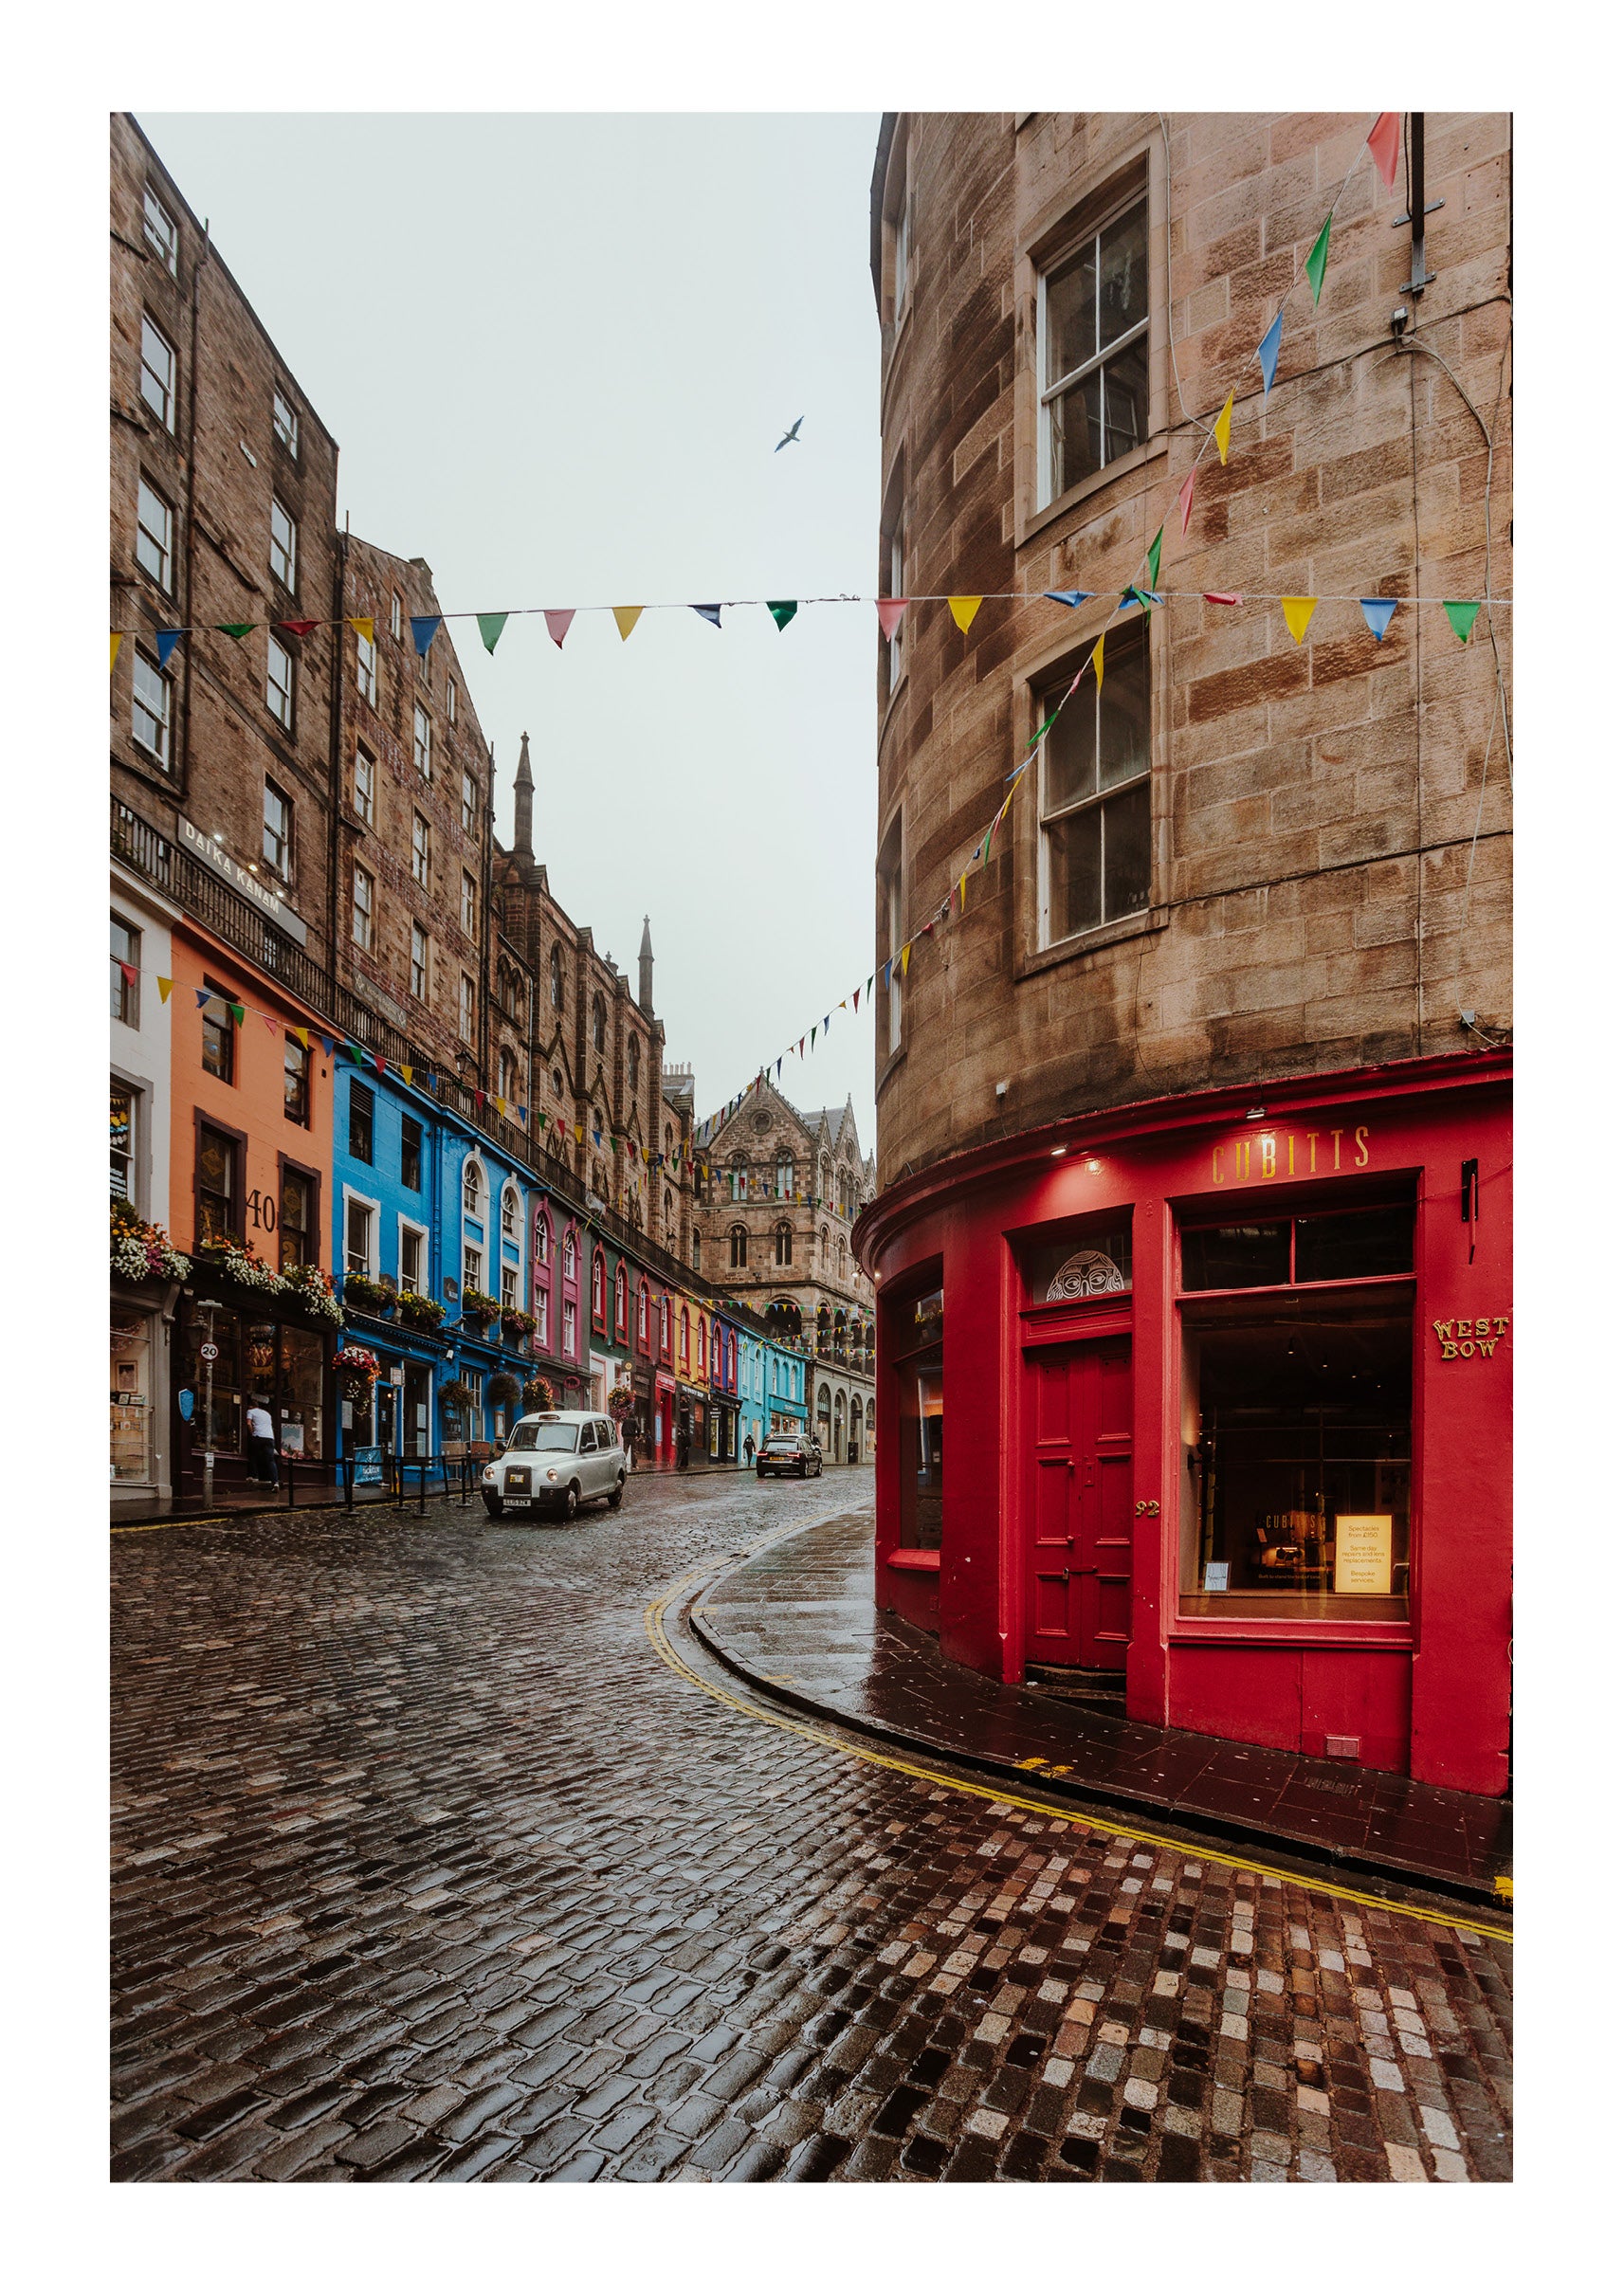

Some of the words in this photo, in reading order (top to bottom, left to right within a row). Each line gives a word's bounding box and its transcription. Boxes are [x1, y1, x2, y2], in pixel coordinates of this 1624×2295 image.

[185, 821, 232, 875] DAIKA
[236, 866, 280, 914] KANAM
[1212, 1125, 1369, 1184] CUBITTS
[246, 1189, 276, 1232] 40
[1432, 1317, 1509, 1341] WEST
[202, 1346, 217, 1357] 20
[1441, 1338, 1499, 1359] BOW
[1135, 1501, 1160, 1517] 92
